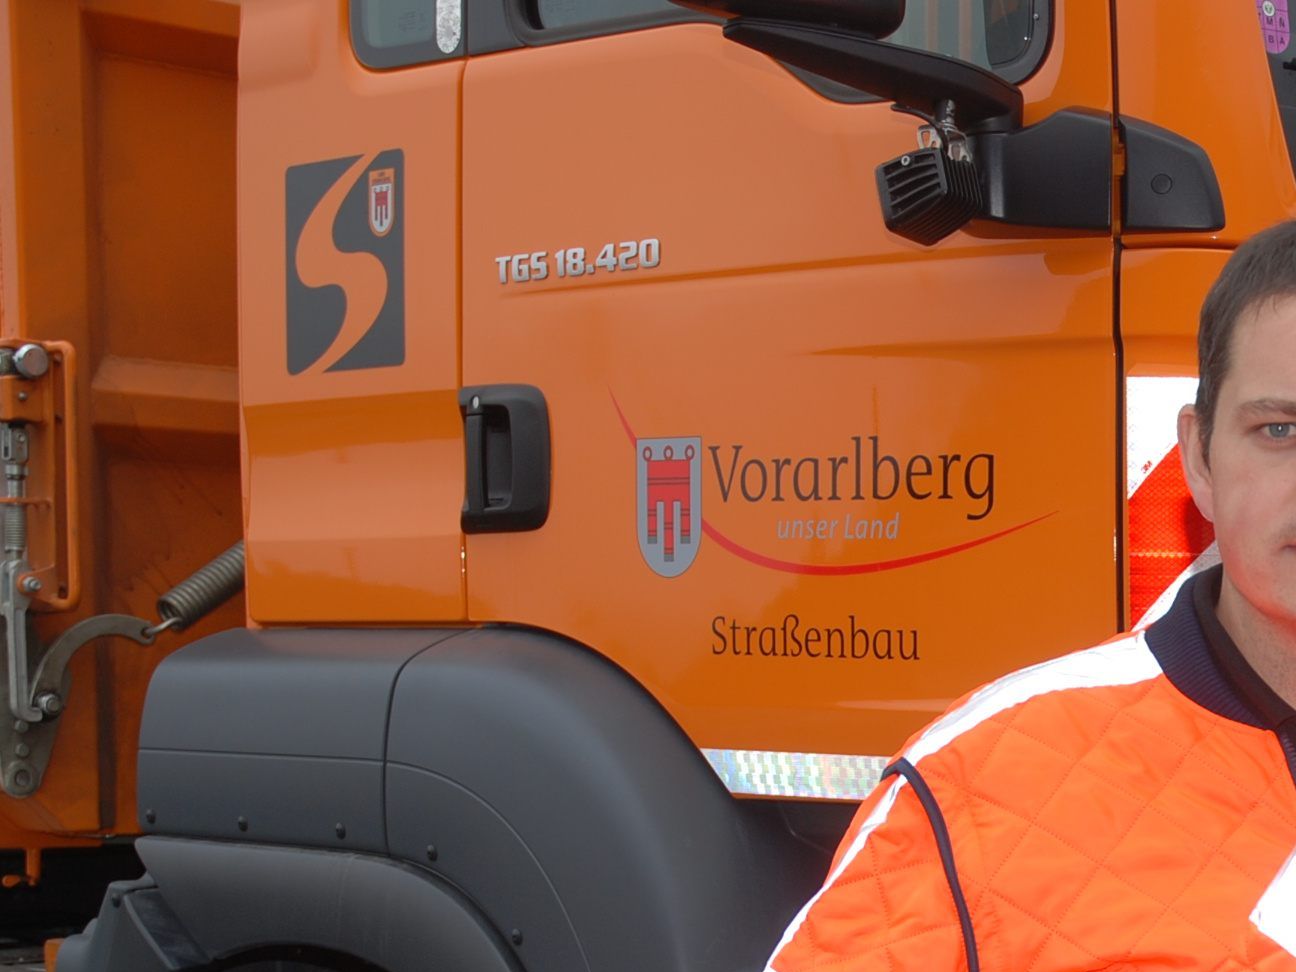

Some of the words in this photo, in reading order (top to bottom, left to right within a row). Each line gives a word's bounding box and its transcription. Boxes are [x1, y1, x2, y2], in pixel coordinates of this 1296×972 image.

[495, 251, 549, 284] TGS
[555, 238, 660, 278] 18.420
[708, 435, 996, 521] Vorarlberg
[776, 516, 838, 540] unser
[844, 511, 900, 540] Land
[711, 613, 920, 661] Straßenbau
